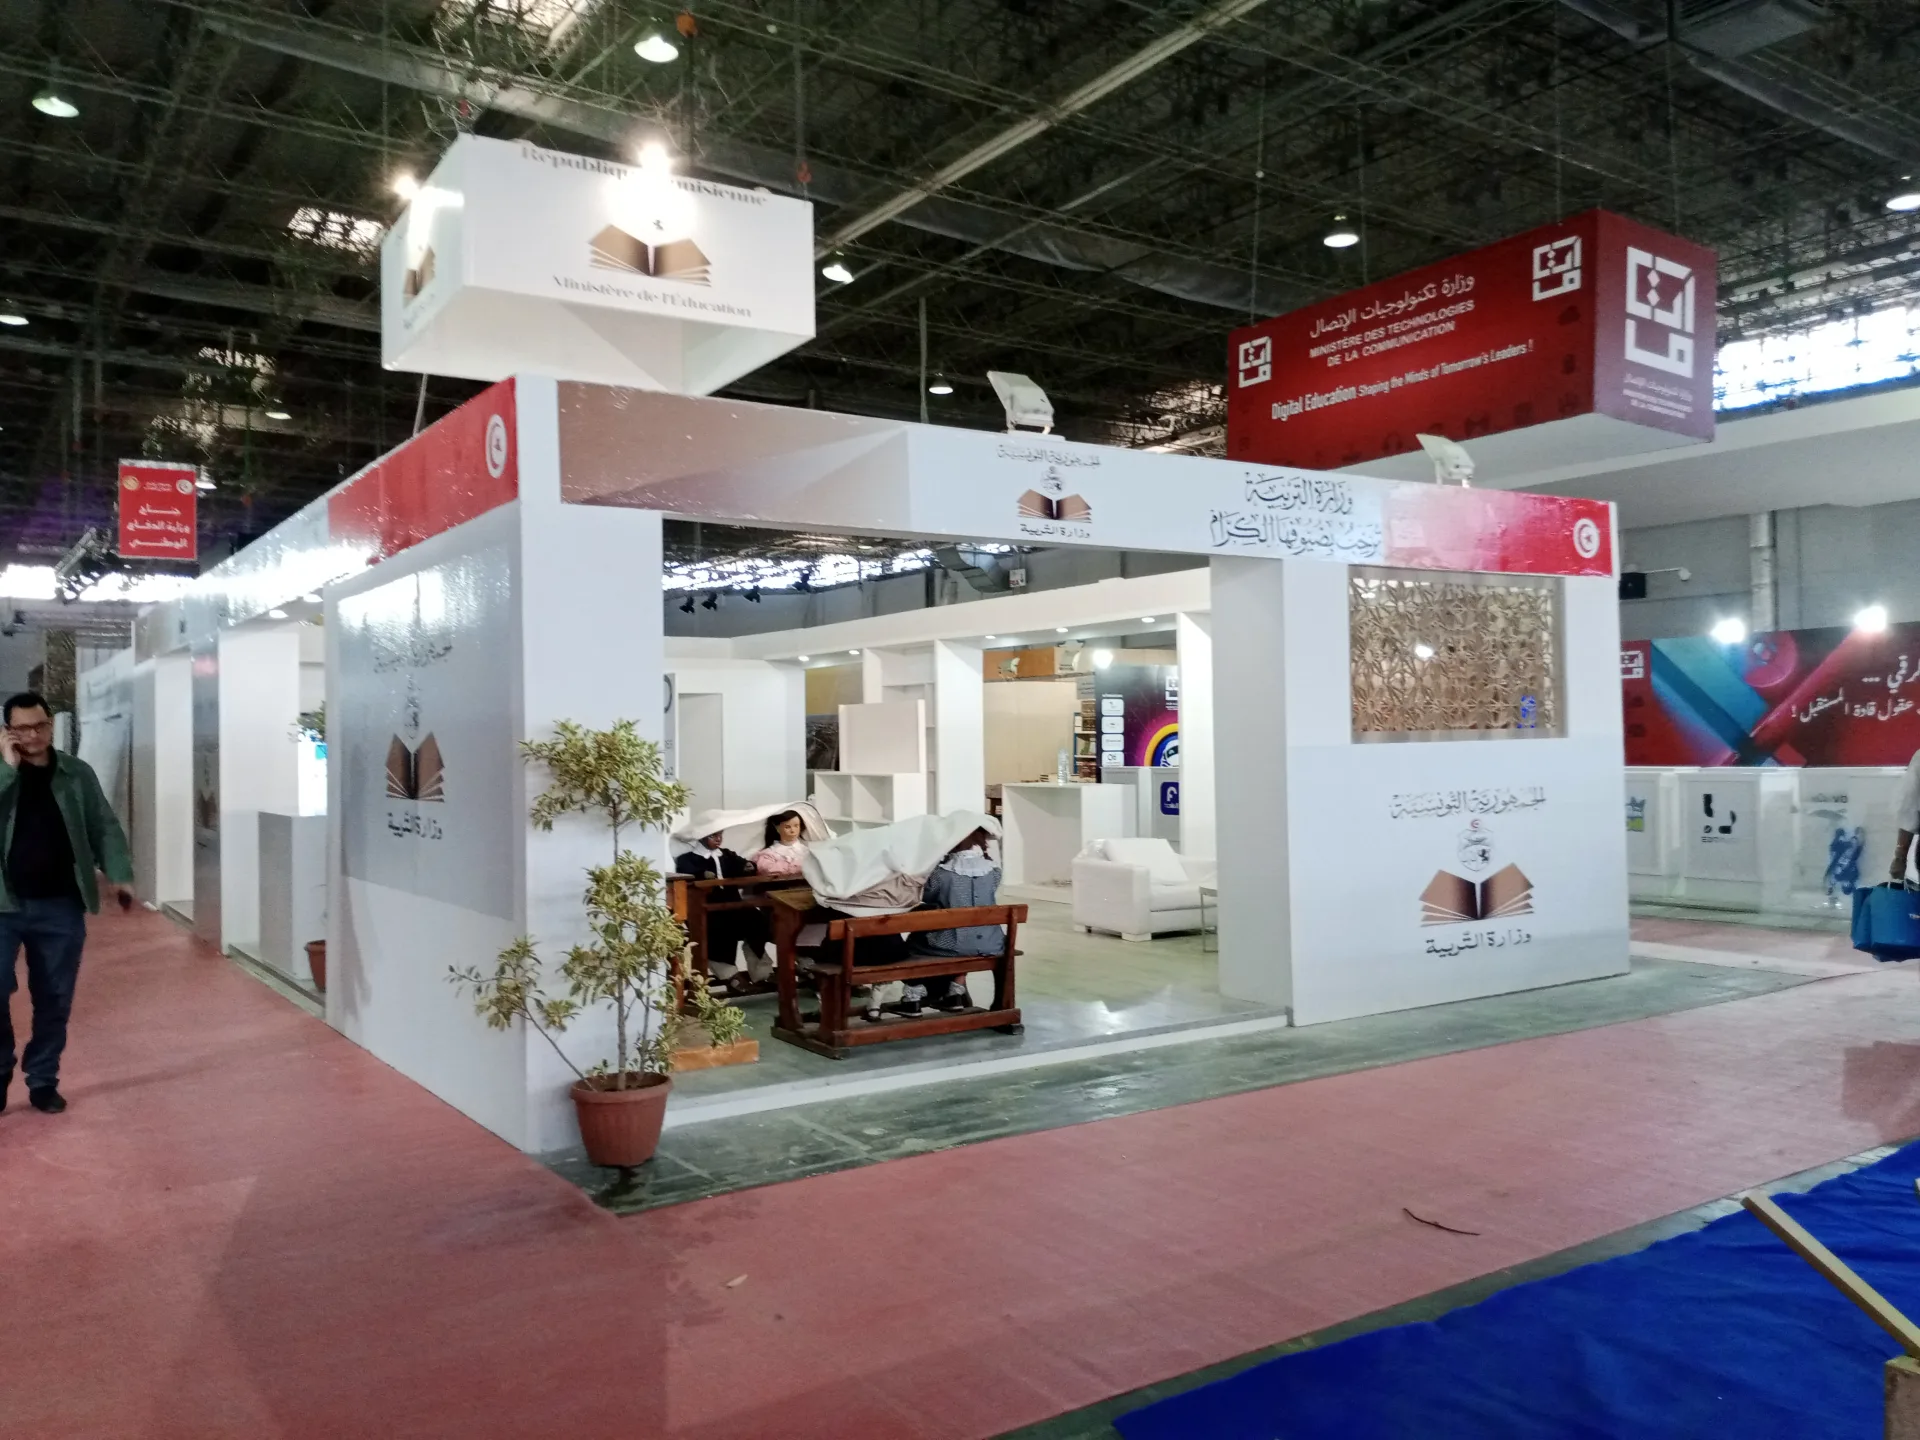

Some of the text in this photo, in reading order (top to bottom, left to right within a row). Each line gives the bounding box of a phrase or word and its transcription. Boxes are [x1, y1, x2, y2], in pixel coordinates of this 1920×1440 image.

[636, 288, 659, 302] de
[1441, 273, 1475, 298] وزارة
[1360, 283, 1437, 320] تكنولوجيات
[1364, 326, 1386, 343] DES
[1387, 299, 1476, 335] TECHNOLOGIES
[1326, 320, 1456, 368] DE LA COMMUNICATION
[1271, 396, 1303, 422] Digital
[1304, 385, 1357, 412] Education
[1357, 380, 1390, 398] Shaping
[1390, 375, 1404, 389] the
[1490, 343, 1527, 363] Leaders
[1059, 526, 1091, 539] وزارة
[1800, 686, 1849, 723] المستقبل
[1877, 698, 1914, 721] عقول
[1486, 929, 1532, 948] وزارة
